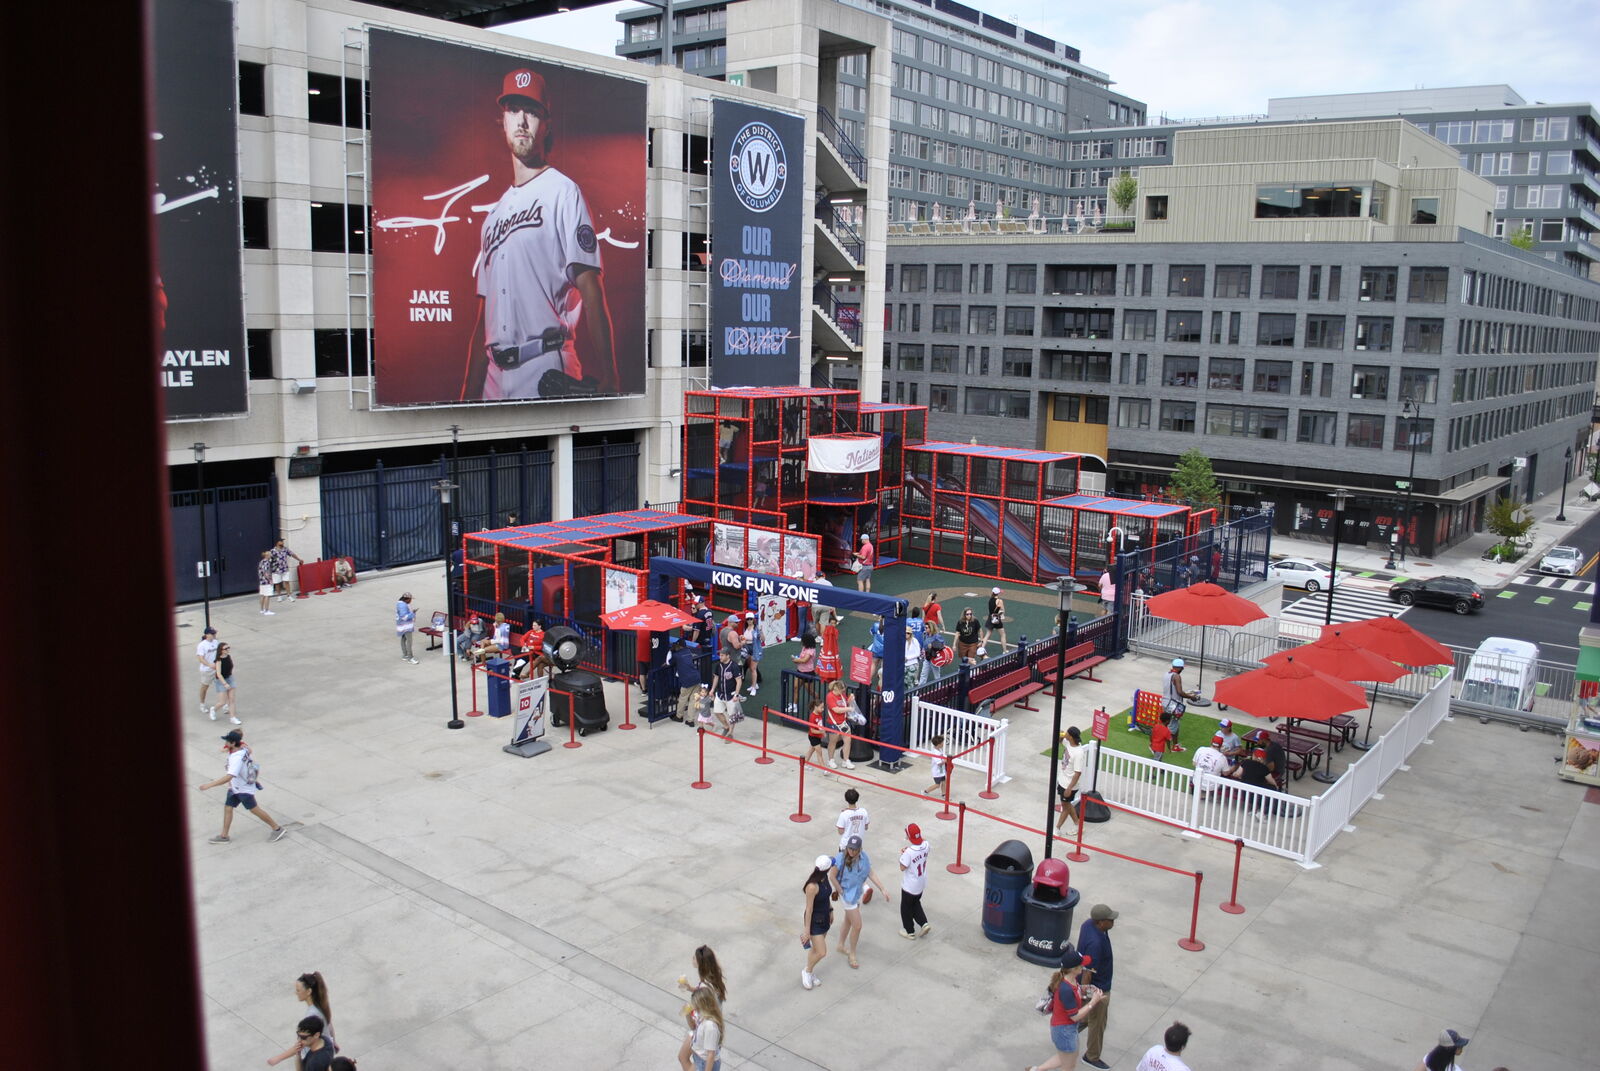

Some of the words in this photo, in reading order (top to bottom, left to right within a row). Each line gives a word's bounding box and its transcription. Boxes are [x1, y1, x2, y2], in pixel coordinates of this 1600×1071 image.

[737, 129, 751, 146] THE
[752, 126, 780, 152] DISTRICT
[747, 150, 770, 188] W
[736, 183, 745, 198] OF
[746, 188, 780, 208] COLUMBIA
[742, 225, 771, 256] OUR
[723, 259, 790, 290] DIAMOND
[409, 290, 449, 304] JAKE
[742, 293, 771, 322] OUR
[410, 307, 452, 322] IRVIN
[724, 327, 788, 355] DISTRICT
[162, 350, 230, 367] AYLEN
[161, 370, 193, 387] ILE
[712, 571, 741, 589] KIDS
[746, 576, 774, 594] FUN
[778, 582, 819, 603] ZONE
[1028, 936, 1053, 950] Coca-Cola
